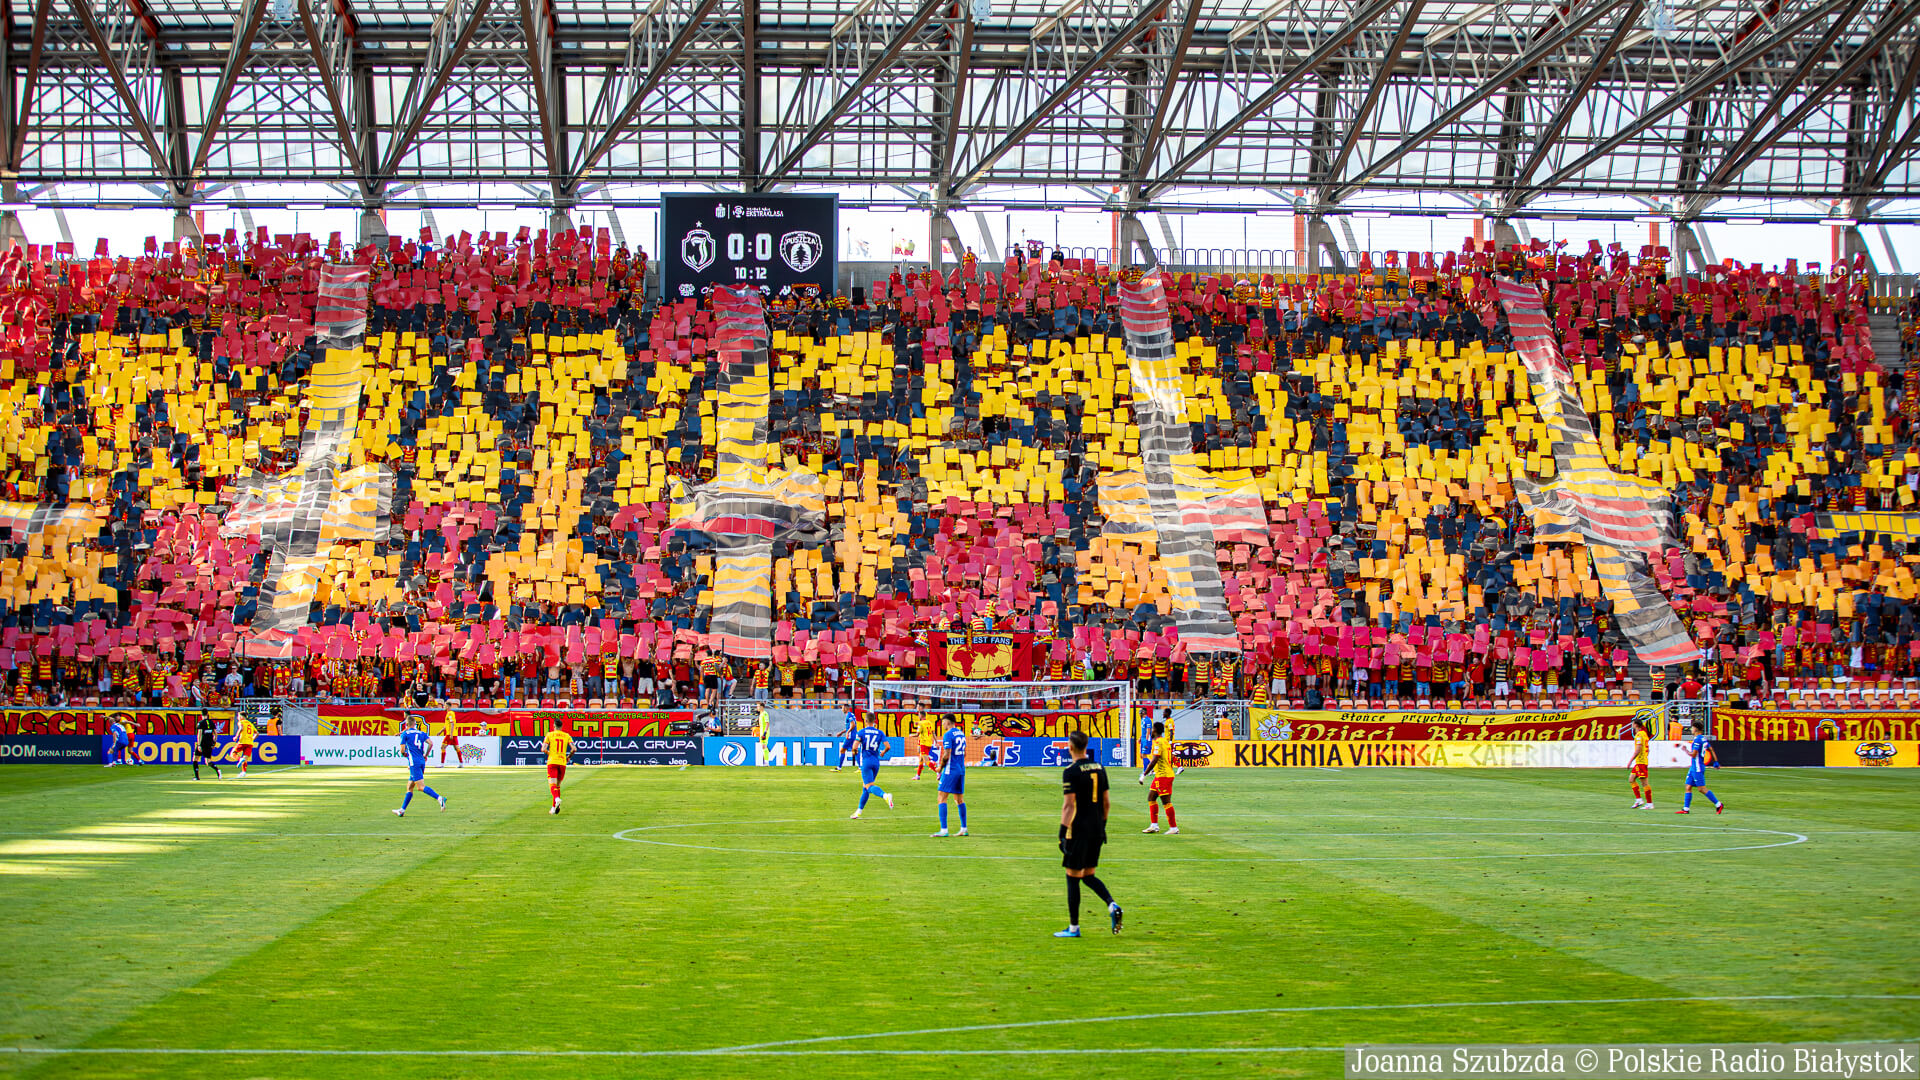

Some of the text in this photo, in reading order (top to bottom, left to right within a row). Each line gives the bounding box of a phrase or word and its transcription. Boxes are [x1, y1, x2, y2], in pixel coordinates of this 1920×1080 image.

[949, 637, 965, 645] THE
[990, 637, 1011, 645] FANS
[260, 704, 269, 712] 22
[741, 705, 750, 713] 21
[613, 712, 650, 720] FOOTBALL
[1401, 712, 1469, 725] przychodzi
[246, 724, 252, 735] 6
[330, 720, 390, 736] ZAWSZE
[414, 733, 422, 749] 4
[555, 740, 638, 750] OJCIULA
[643, 740, 697, 750] GRUPA
[555, 738, 564, 753] 11
[864, 734, 879, 751] 14
[313, 746, 434, 761] www.podlasku
[982, 740, 1021, 766] STS
[1234, 743, 1344, 767] KUCHNIA
[1348, 743, 1449, 767] VIKINGA
[1469, 743, 1580, 767] CATERING
[668, 757, 688, 766] Jeep
[1090, 772, 1099, 803] 1
